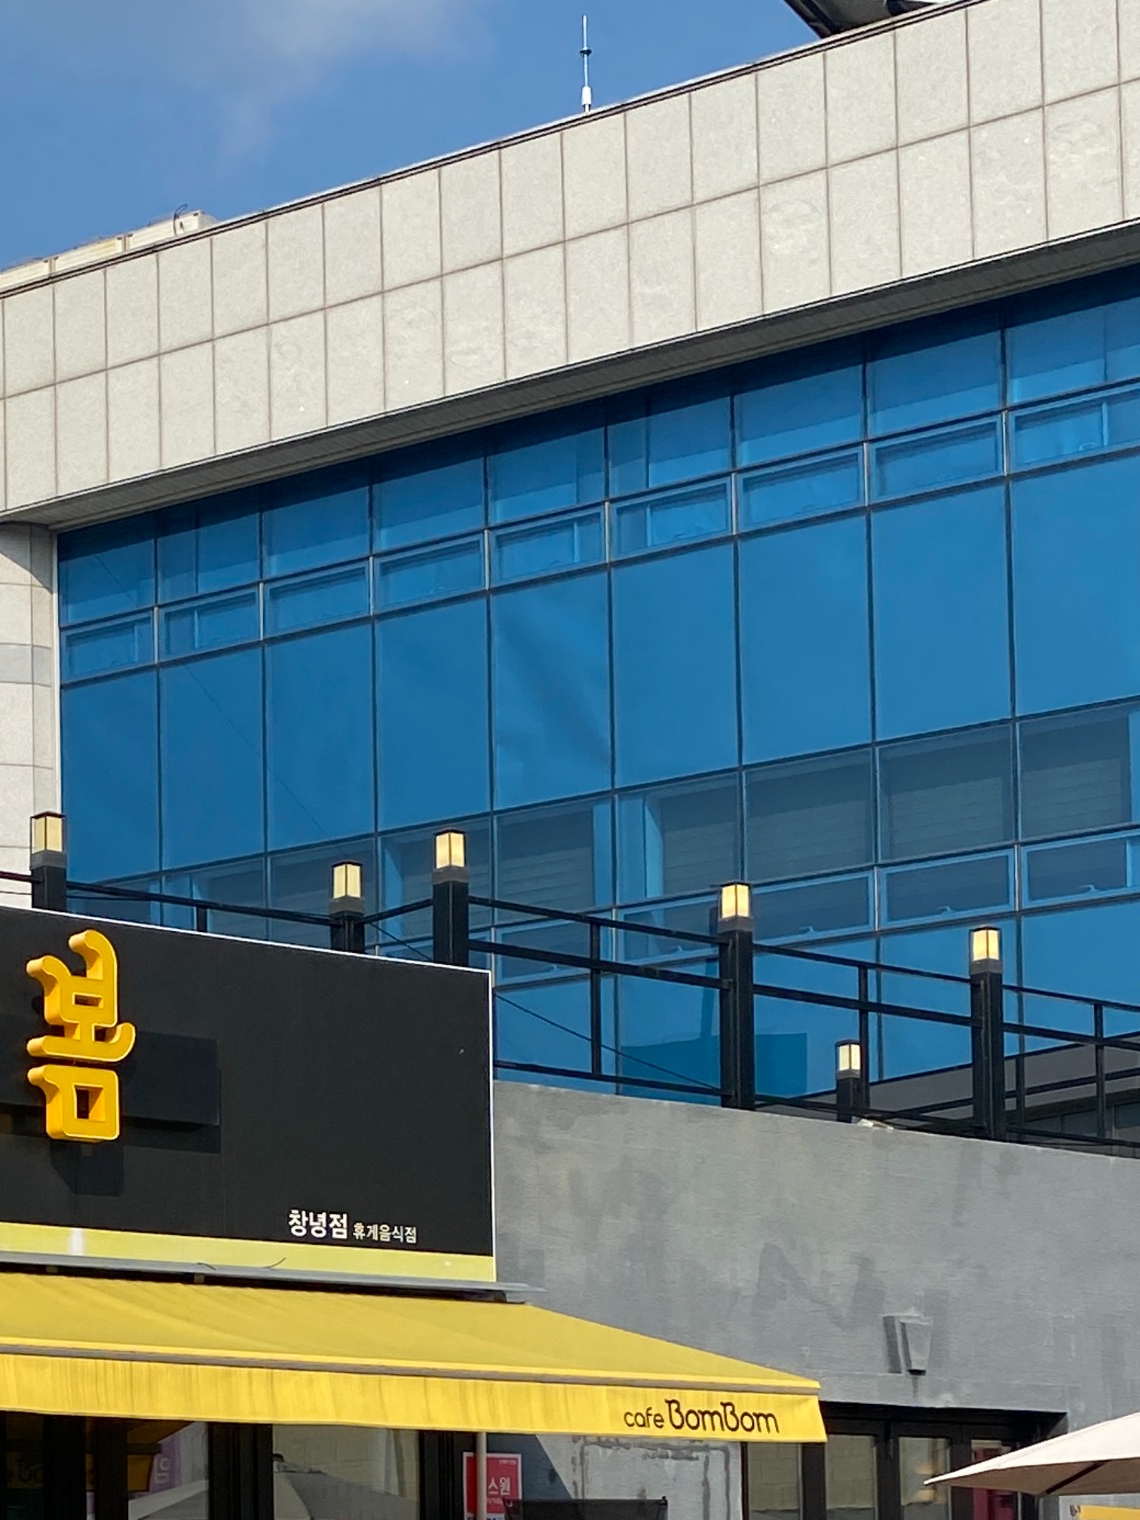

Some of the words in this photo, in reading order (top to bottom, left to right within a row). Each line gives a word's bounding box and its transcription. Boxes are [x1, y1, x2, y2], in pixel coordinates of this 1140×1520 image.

[288, 1209, 349, 1240] 창녕점
[353, 1221, 418, 1245] 휴게음식점
[624, 1406, 664, 1429] cafe
[664, 1398, 780, 1433] BomBom
